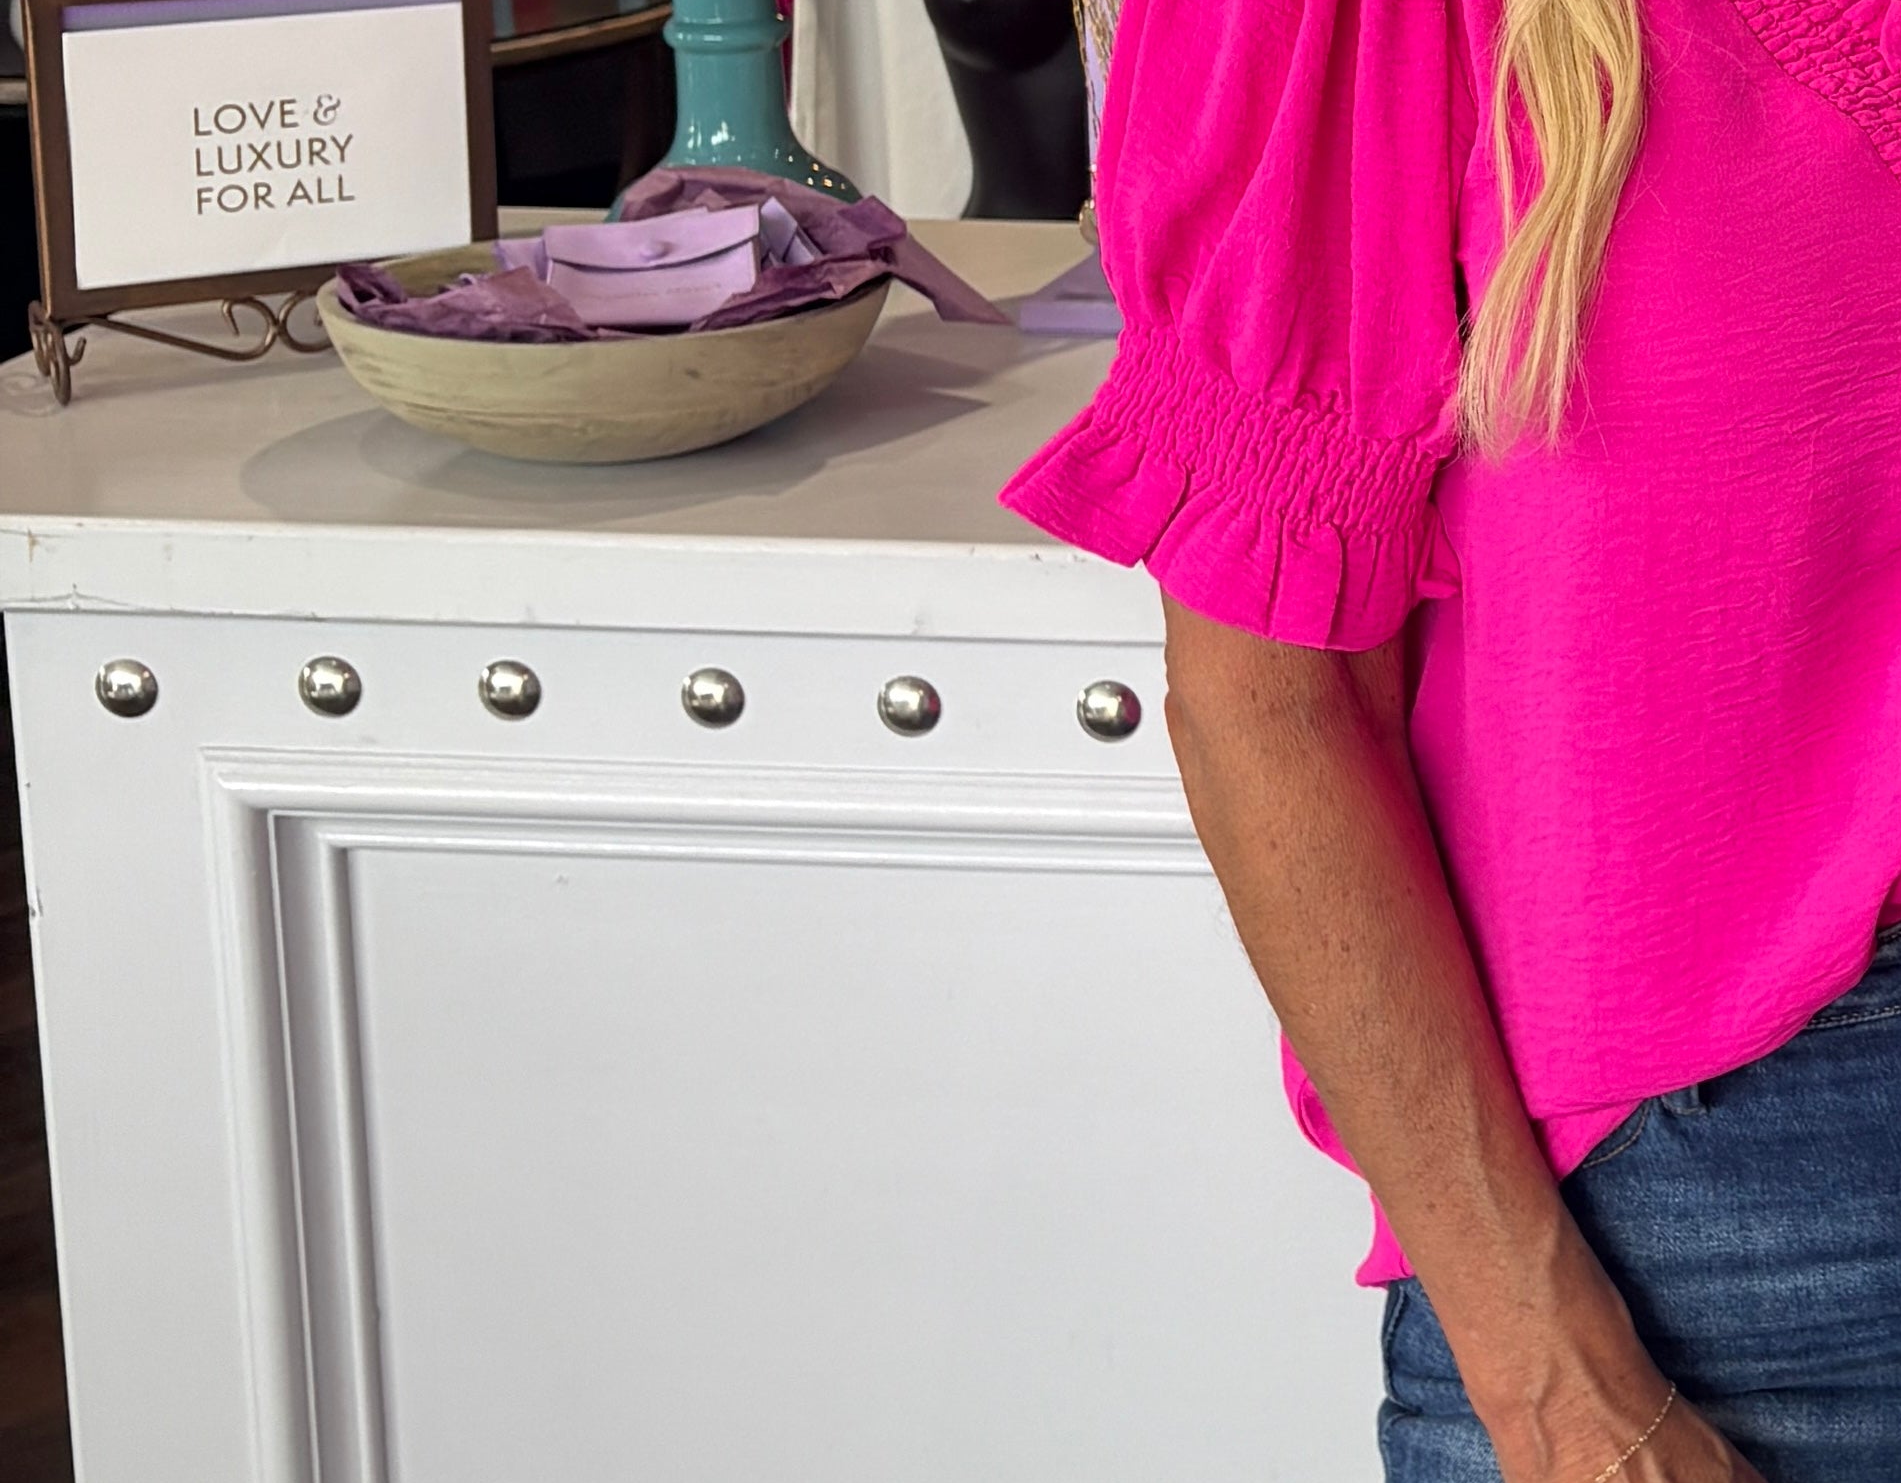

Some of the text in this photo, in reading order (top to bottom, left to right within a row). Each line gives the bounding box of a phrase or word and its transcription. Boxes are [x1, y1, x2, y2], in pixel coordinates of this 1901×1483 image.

[194, 93, 341, 137] LOVE &
[195, 133, 353, 177] LUXURY
[197, 174, 355, 215] FOR ALL
